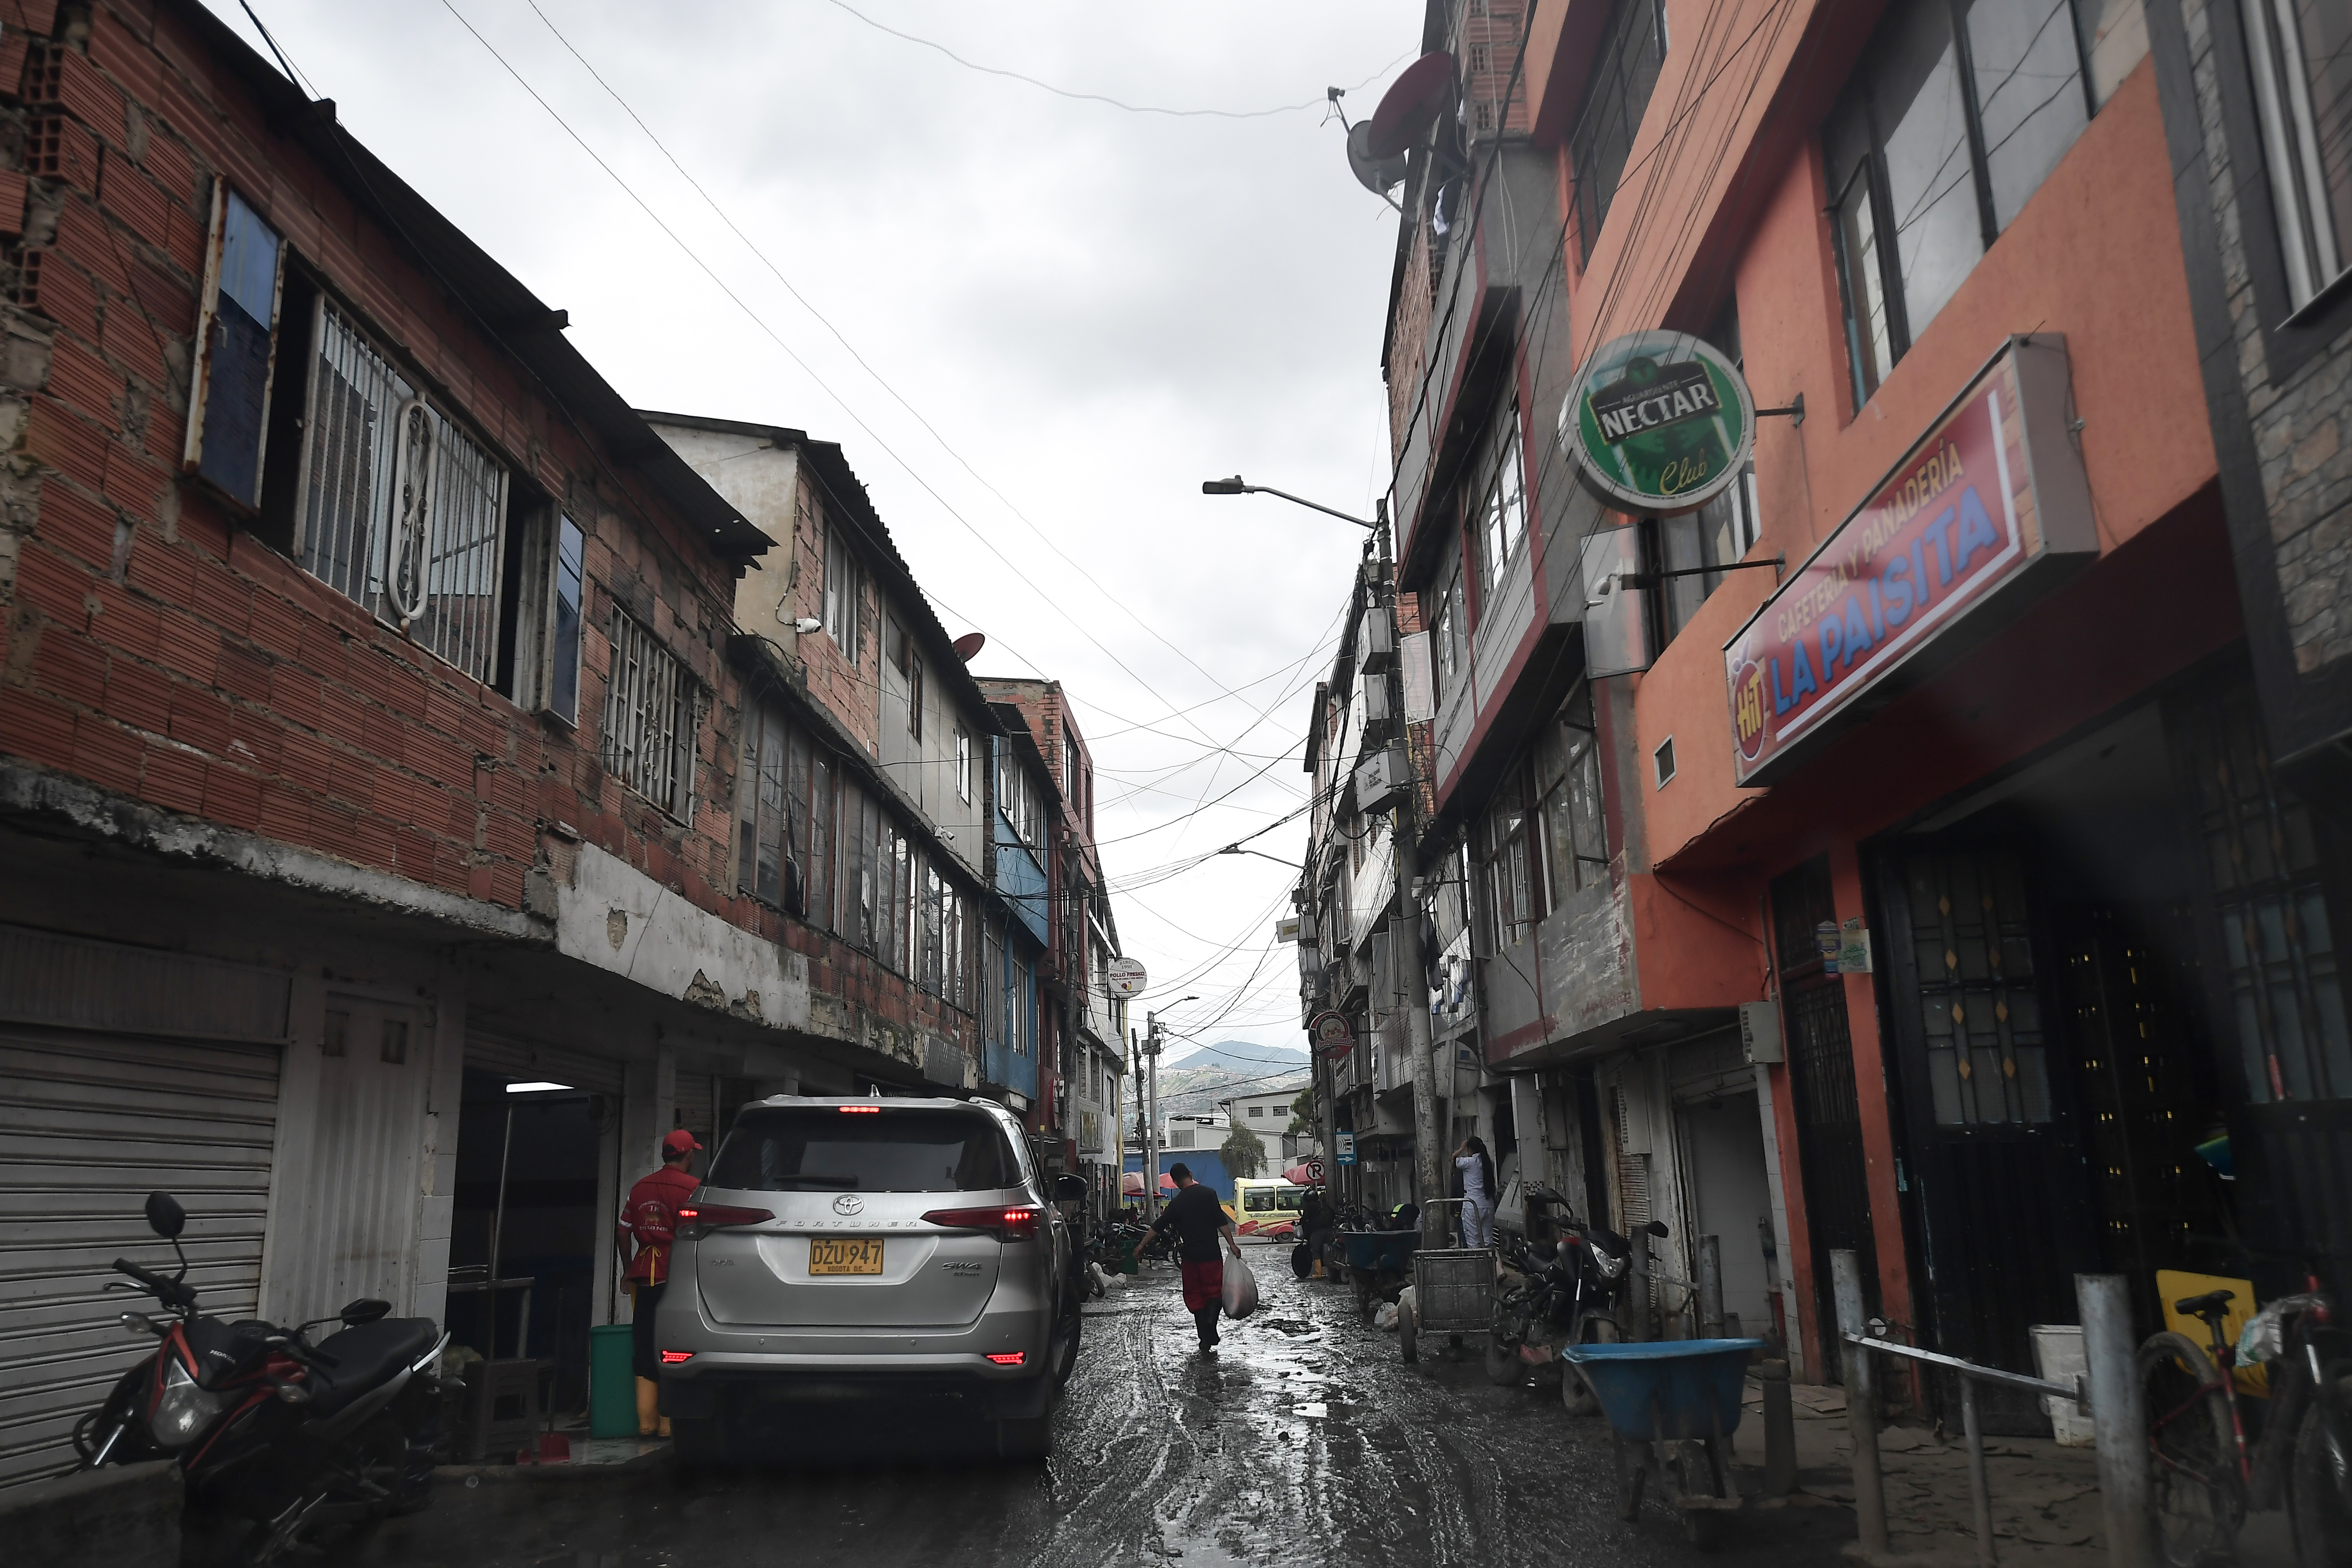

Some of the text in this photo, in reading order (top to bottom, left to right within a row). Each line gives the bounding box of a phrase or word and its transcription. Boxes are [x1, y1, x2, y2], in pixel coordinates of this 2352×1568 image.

[1601, 383, 1715, 439] NECTAR
[1659, 449, 1708, 495] Club
[1778, 438, 1964, 643] CAFETERÍA Y PANADERÍA
[1770, 485, 1998, 718] LA PAISITA
[1312, 1164, 1321, 1177] P
[812, 1245, 881, 1265] DZU 947
[942, 1261, 982, 1270] SW4
[209, 1349, 235, 1364] HONDA
